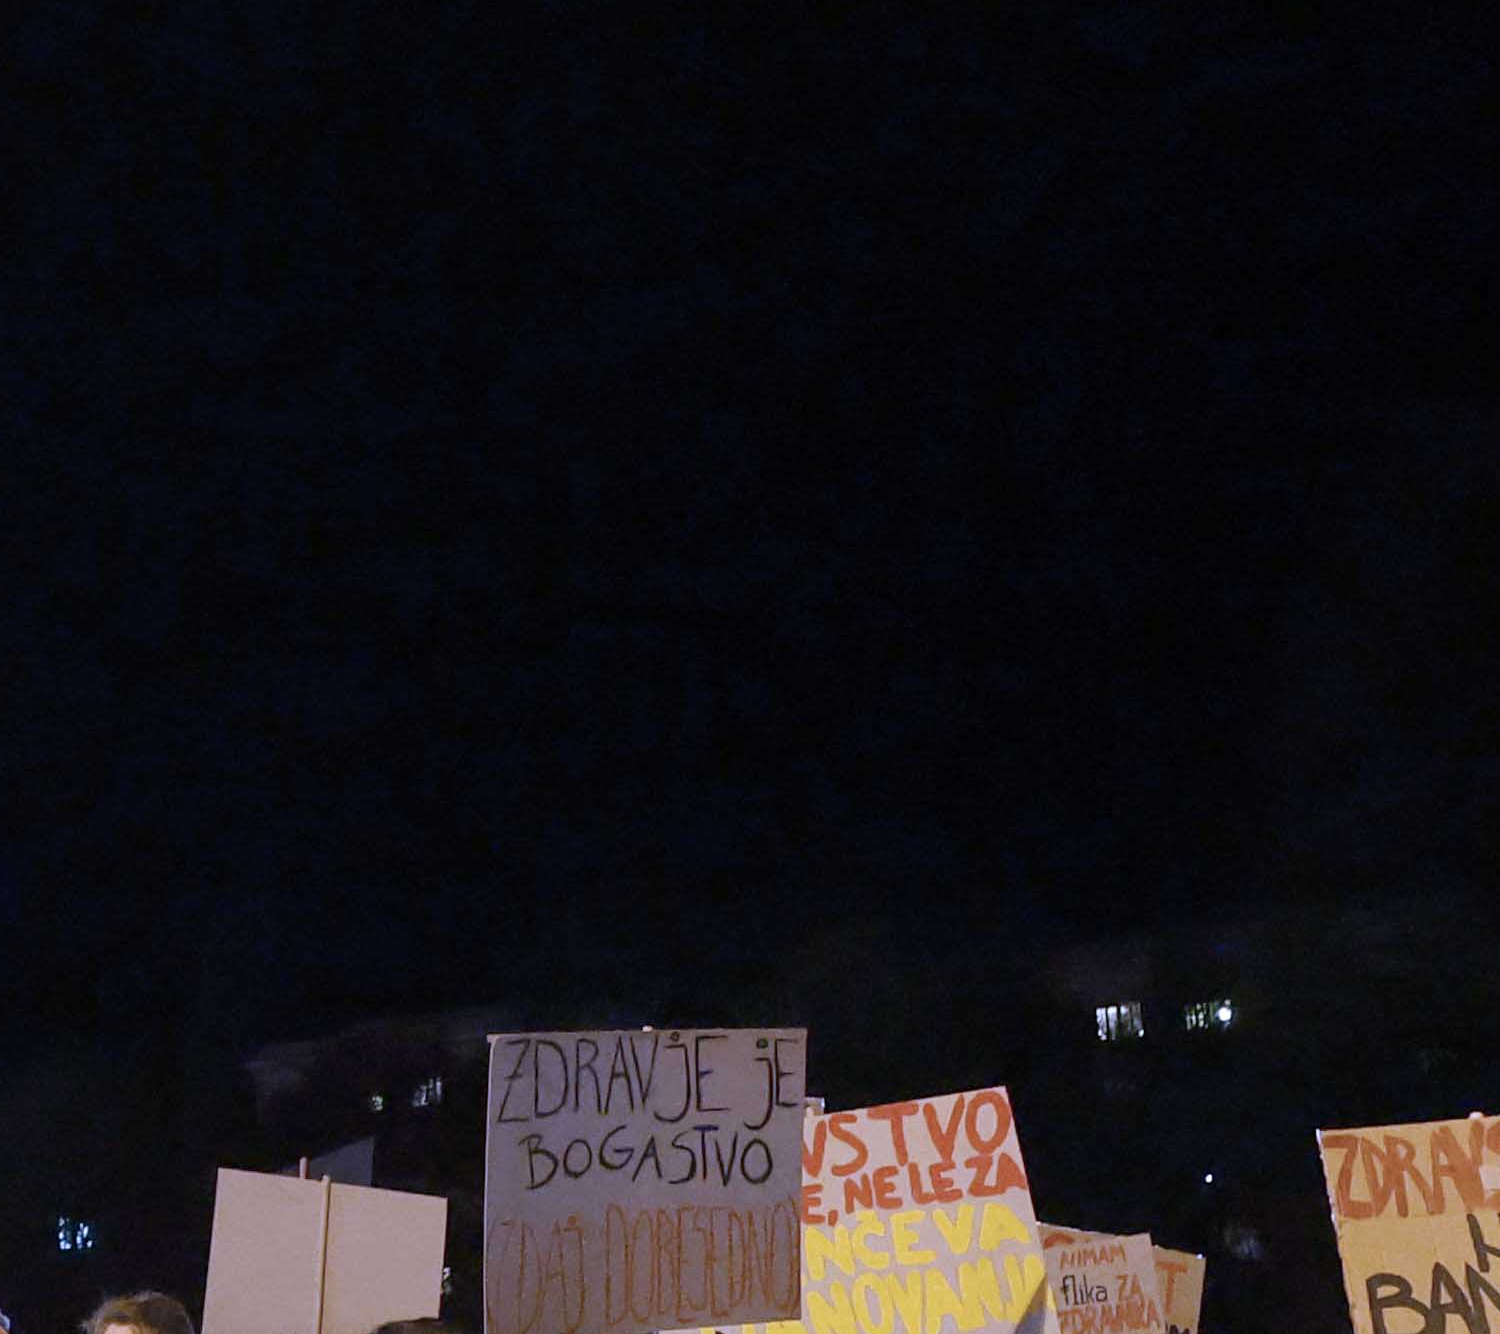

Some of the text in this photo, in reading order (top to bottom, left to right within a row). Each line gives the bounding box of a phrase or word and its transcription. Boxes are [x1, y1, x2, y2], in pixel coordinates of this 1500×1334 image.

[519, 1124, 773, 1190] BOGASTVO
[802, 1090, 1012, 1178] VSTVO
[965, 1152, 1029, 1197] ZA
